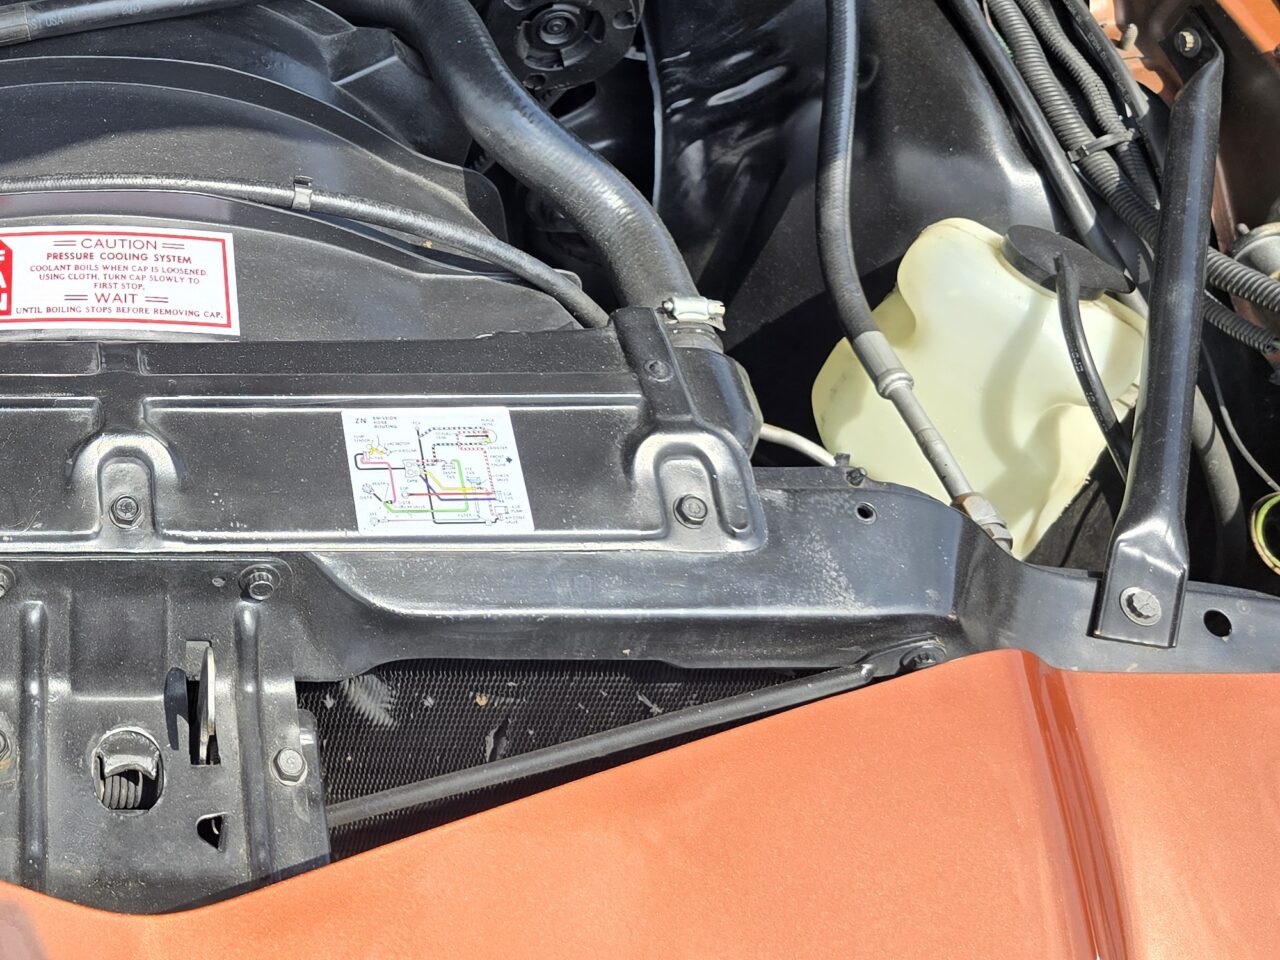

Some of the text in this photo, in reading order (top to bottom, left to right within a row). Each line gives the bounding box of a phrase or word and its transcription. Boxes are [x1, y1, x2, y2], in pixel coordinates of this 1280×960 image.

[80, 238, 157, 250] CAUTION
[46, 252, 192, 264] PRESSURE COOLING SYSTEM
[30, 264, 71, 272] COOLANT
[149, 275, 184, 283] SLOWLY
[94, 292, 138, 304] WAIT
[116, 306, 150, 314] BEFORE
[153, 308, 200, 317] REMOVING
